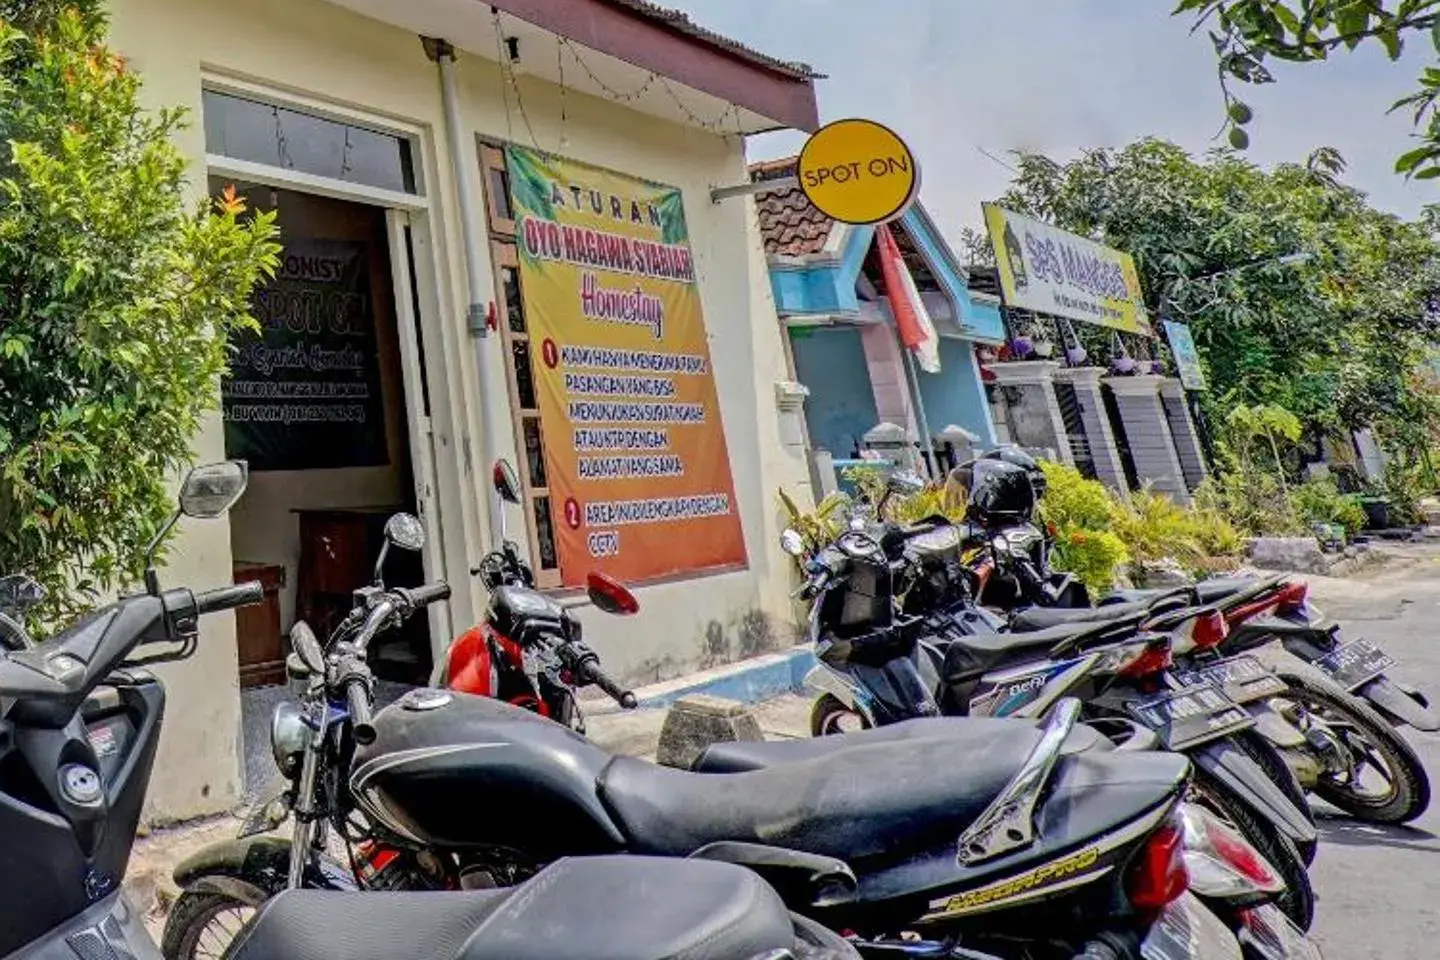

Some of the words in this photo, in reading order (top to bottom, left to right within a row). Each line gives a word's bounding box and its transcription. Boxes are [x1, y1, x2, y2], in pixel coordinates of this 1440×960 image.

[804, 162, 860, 187] SPOT
[868, 156, 908, 177] ON
[551, 181, 662, 227] ATURAN
[524, 216, 561, 259] OYO
[582, 273, 663, 338] Homestay
